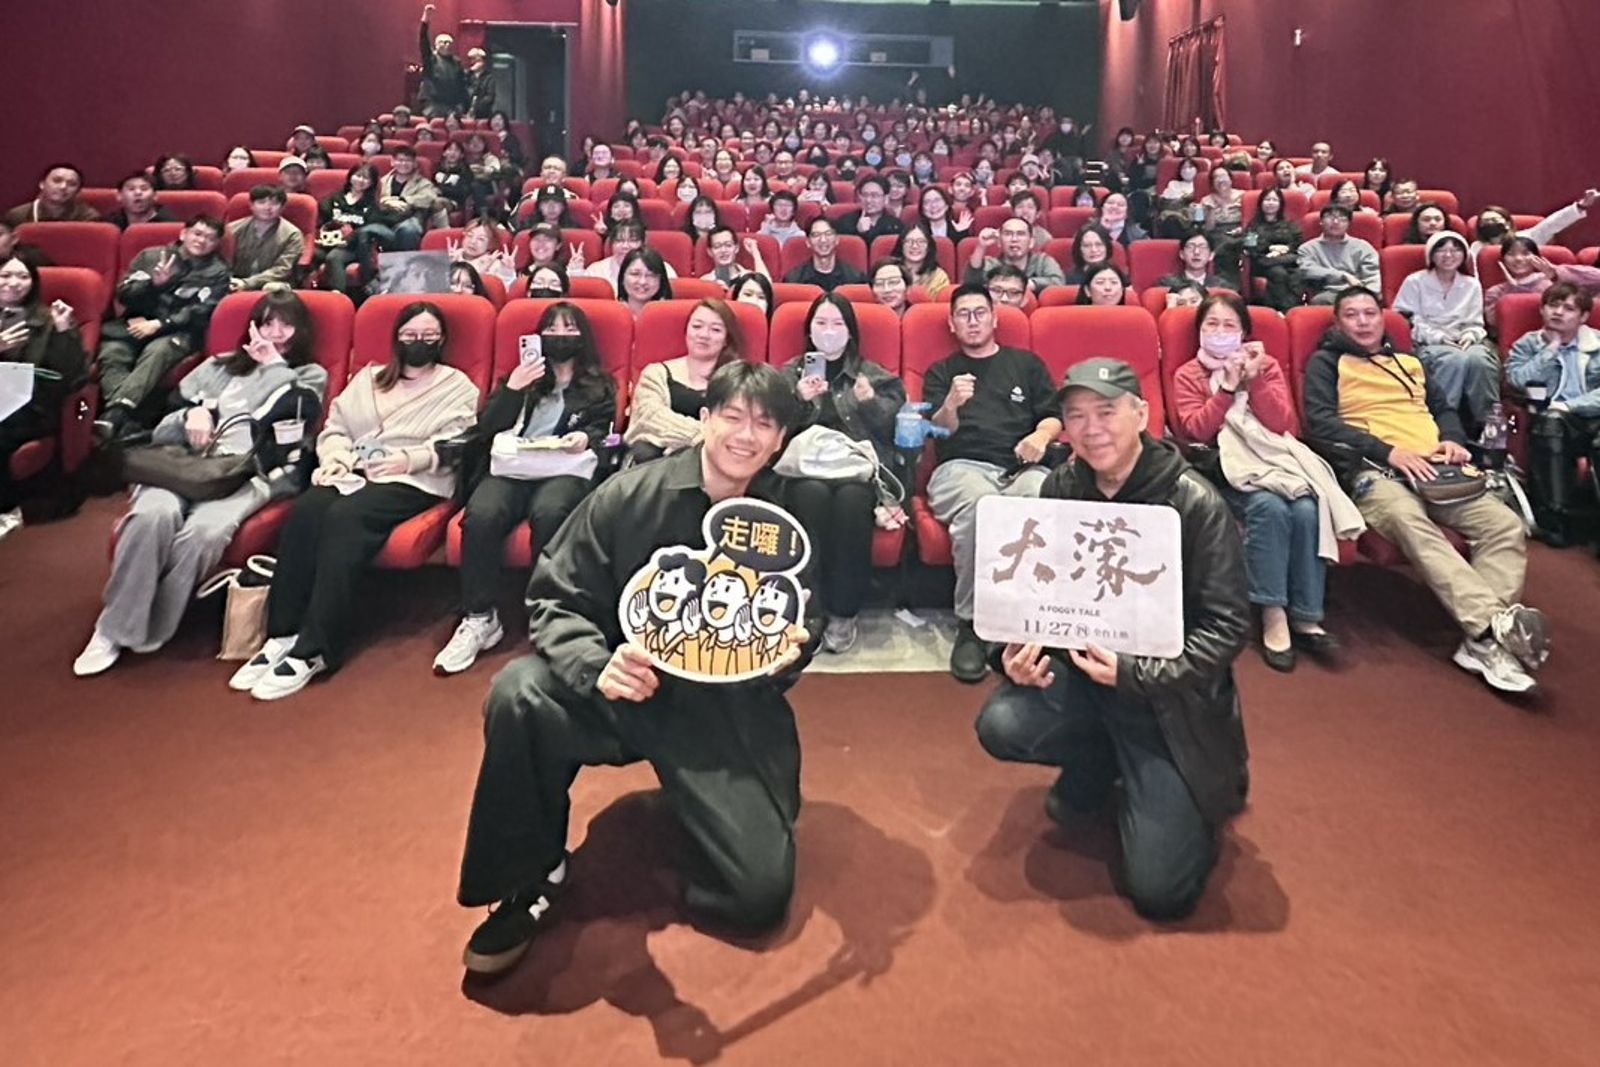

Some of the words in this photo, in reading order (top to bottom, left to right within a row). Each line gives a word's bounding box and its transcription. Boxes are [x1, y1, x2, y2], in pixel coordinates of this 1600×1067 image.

[1047, 606, 1076, 614] FOGGY
[1078, 608, 1101, 616] TALE
[1024, 619, 1072, 636] 11/27
